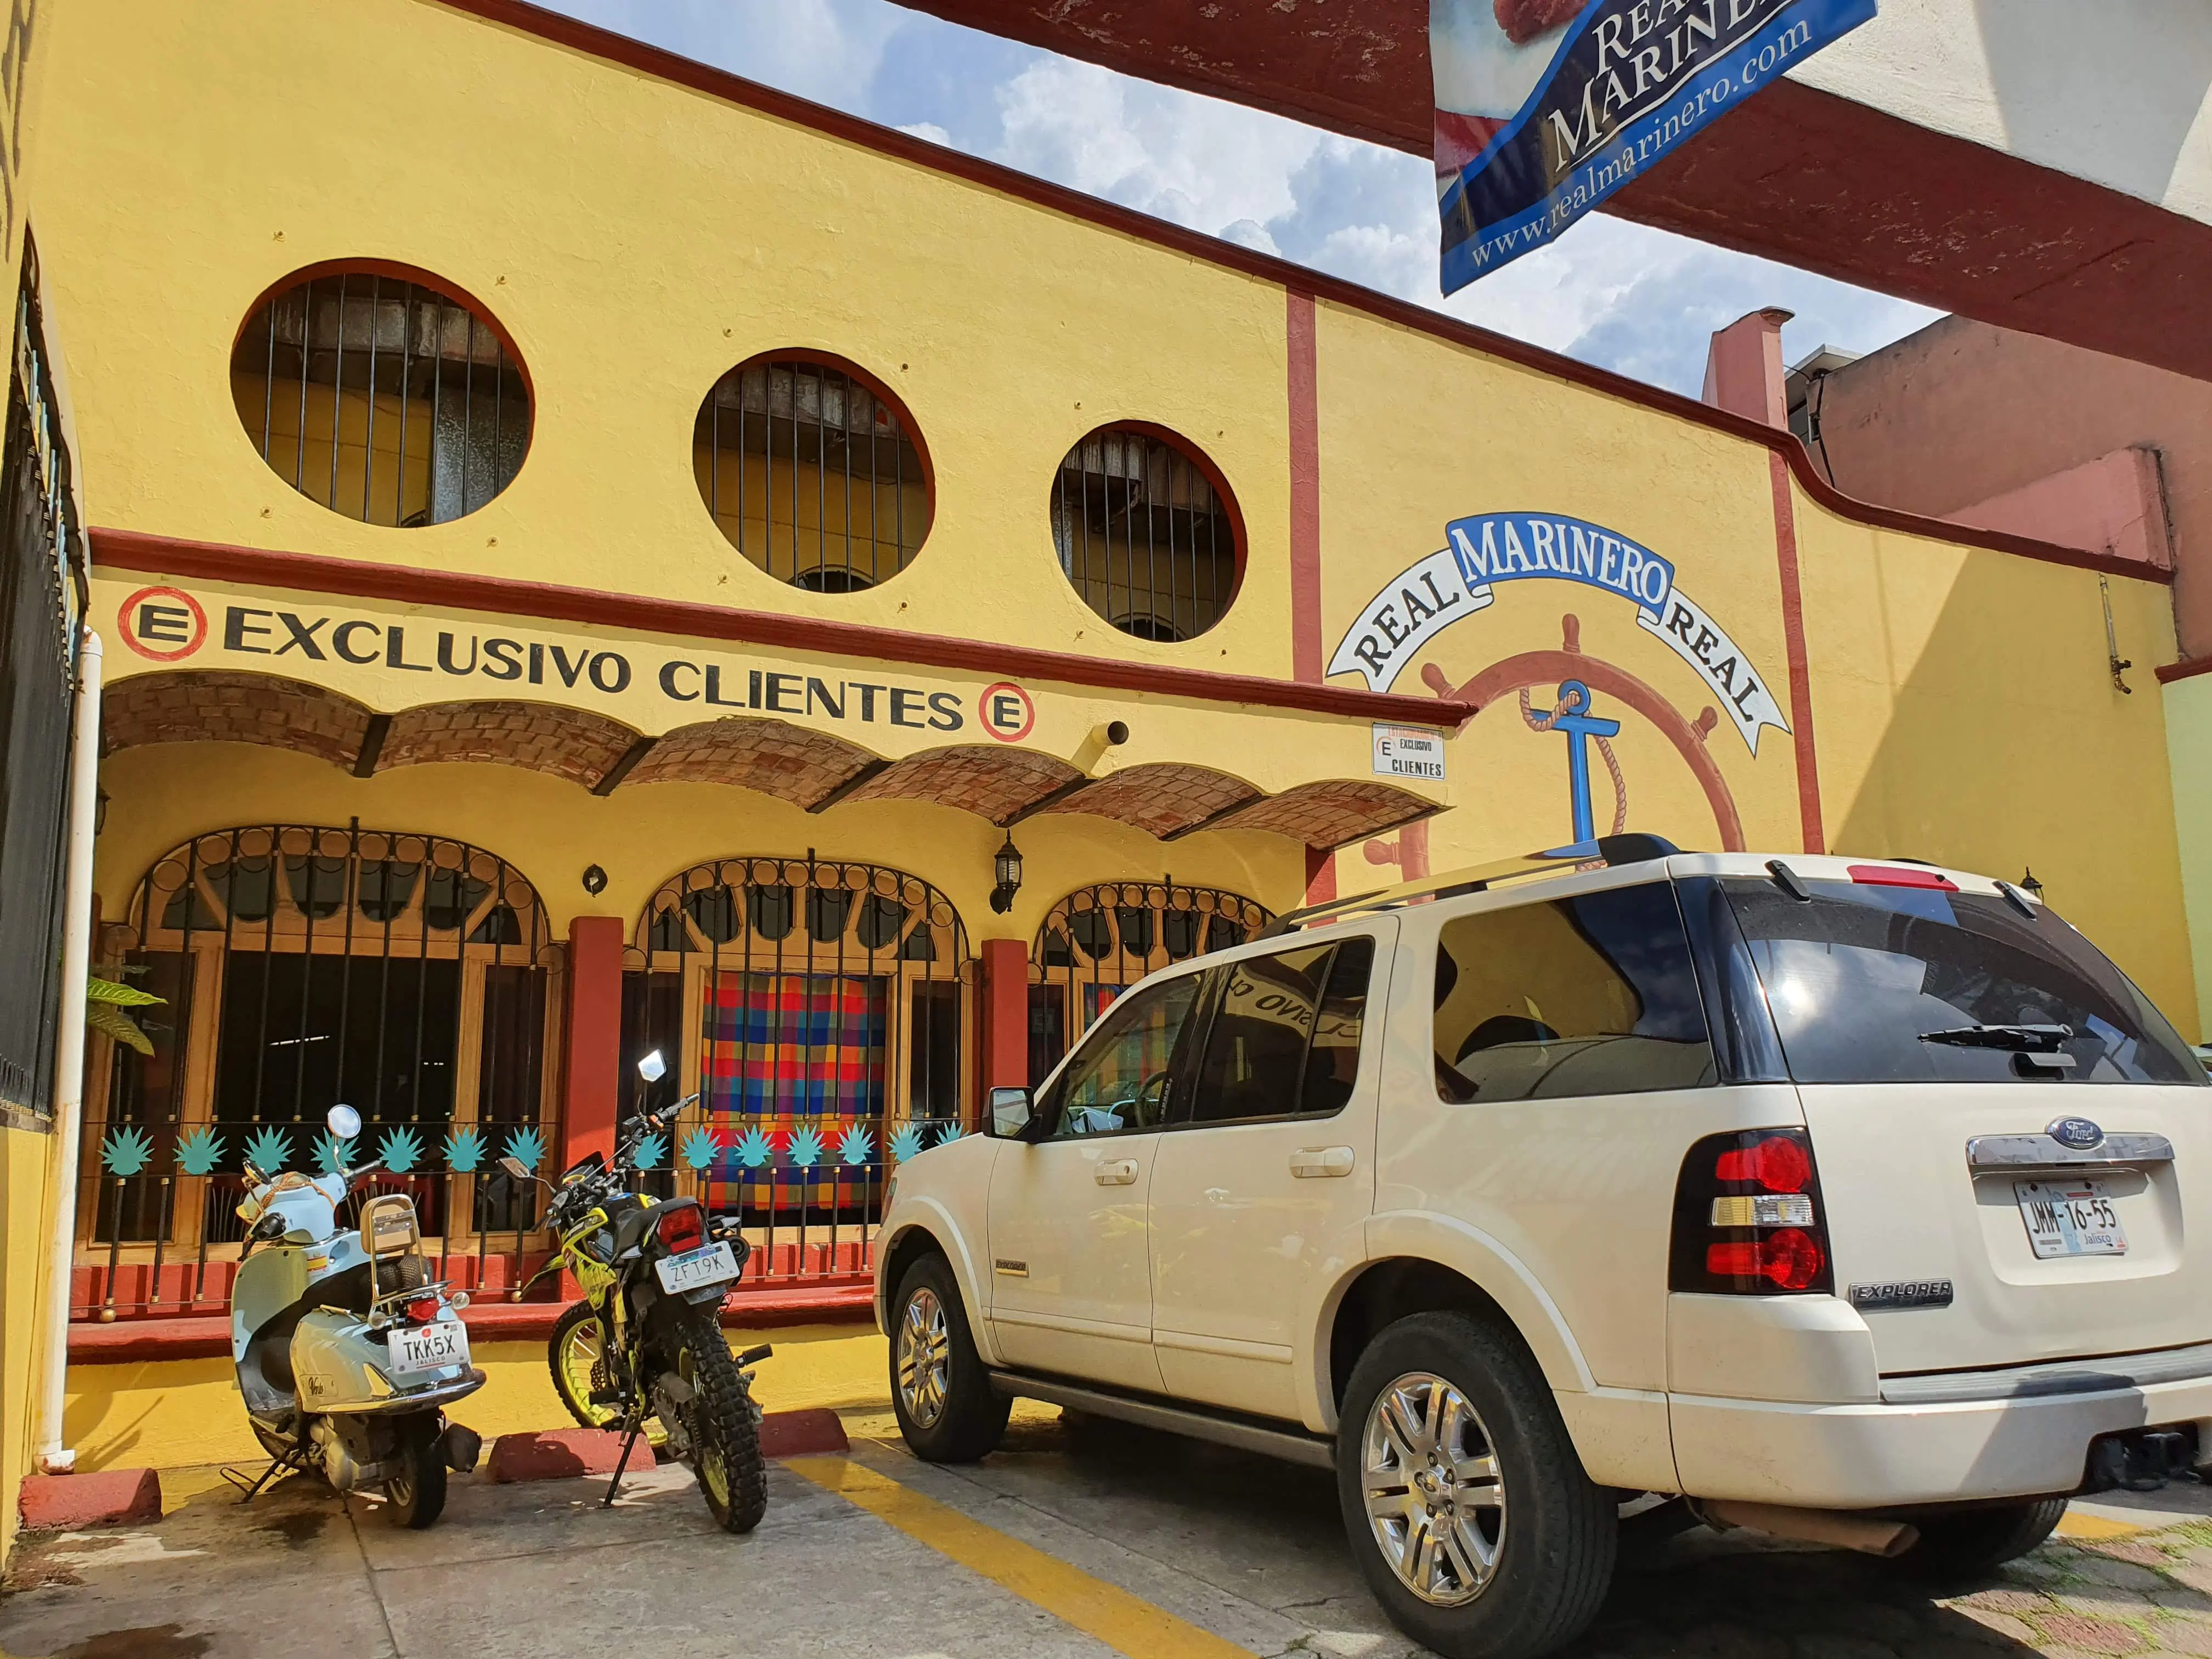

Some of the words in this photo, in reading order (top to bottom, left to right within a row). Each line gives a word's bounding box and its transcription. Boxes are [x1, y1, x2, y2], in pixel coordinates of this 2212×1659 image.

[1592, 0, 1691, 80] REA
[1472, 20, 1812, 268] www.realmarinero.com
[1355, 571, 1460, 677] REAL
[1451, 519, 1668, 606] MARINERO
[1668, 601, 1767, 723] REAL
[138, 603, 190, 642] E
[223, 605, 631, 693] EXCLUSIVO
[658, 660, 963, 731] CLIENTES
[994, 695, 1021, 729] E
[1382, 741, 1392, 757] E
[1400, 738, 1432, 752] EXCLUSIVO
[1391, 759, 1442, 777] CLIENTES
[2065, 1121, 2095, 1140] Ford
[2030, 1199, 2116, 1234] JMM-16-55
[2085, 1233, 2112, 1245] Jalisco
[671, 1255, 724, 1282] ZFT9K
[1855, 1281, 1951, 1299] EXPLORER
[403, 1334, 456, 1361] TKK5X
[415, 1356, 445, 1365] JALISCO
